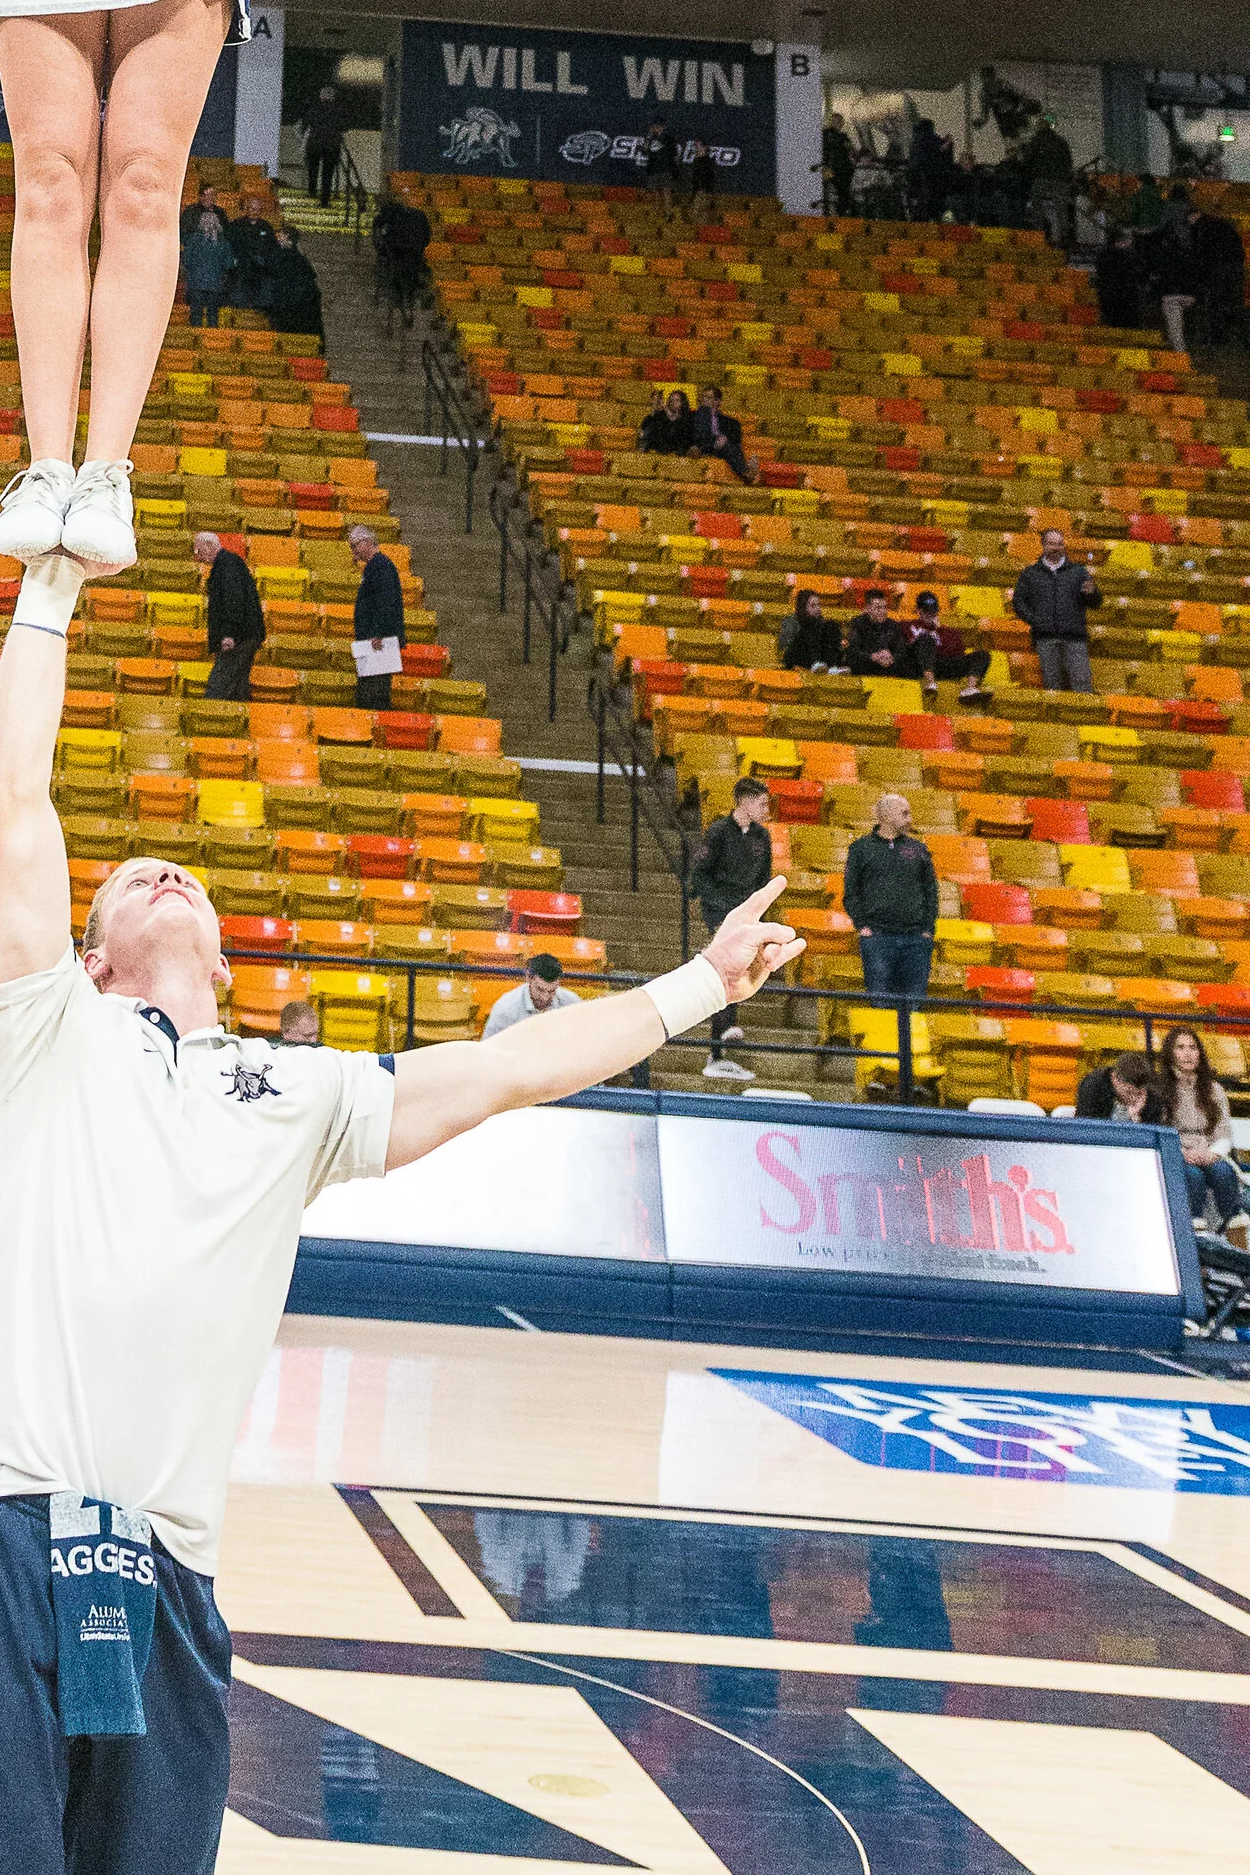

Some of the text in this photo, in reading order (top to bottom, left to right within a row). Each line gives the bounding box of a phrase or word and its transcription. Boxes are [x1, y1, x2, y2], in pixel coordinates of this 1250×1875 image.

[252, 15, 272, 39] A
[442, 43, 746, 106] WILL WIN
[791, 54, 810, 77] B
[88, 1604, 127, 1619] ALUM
